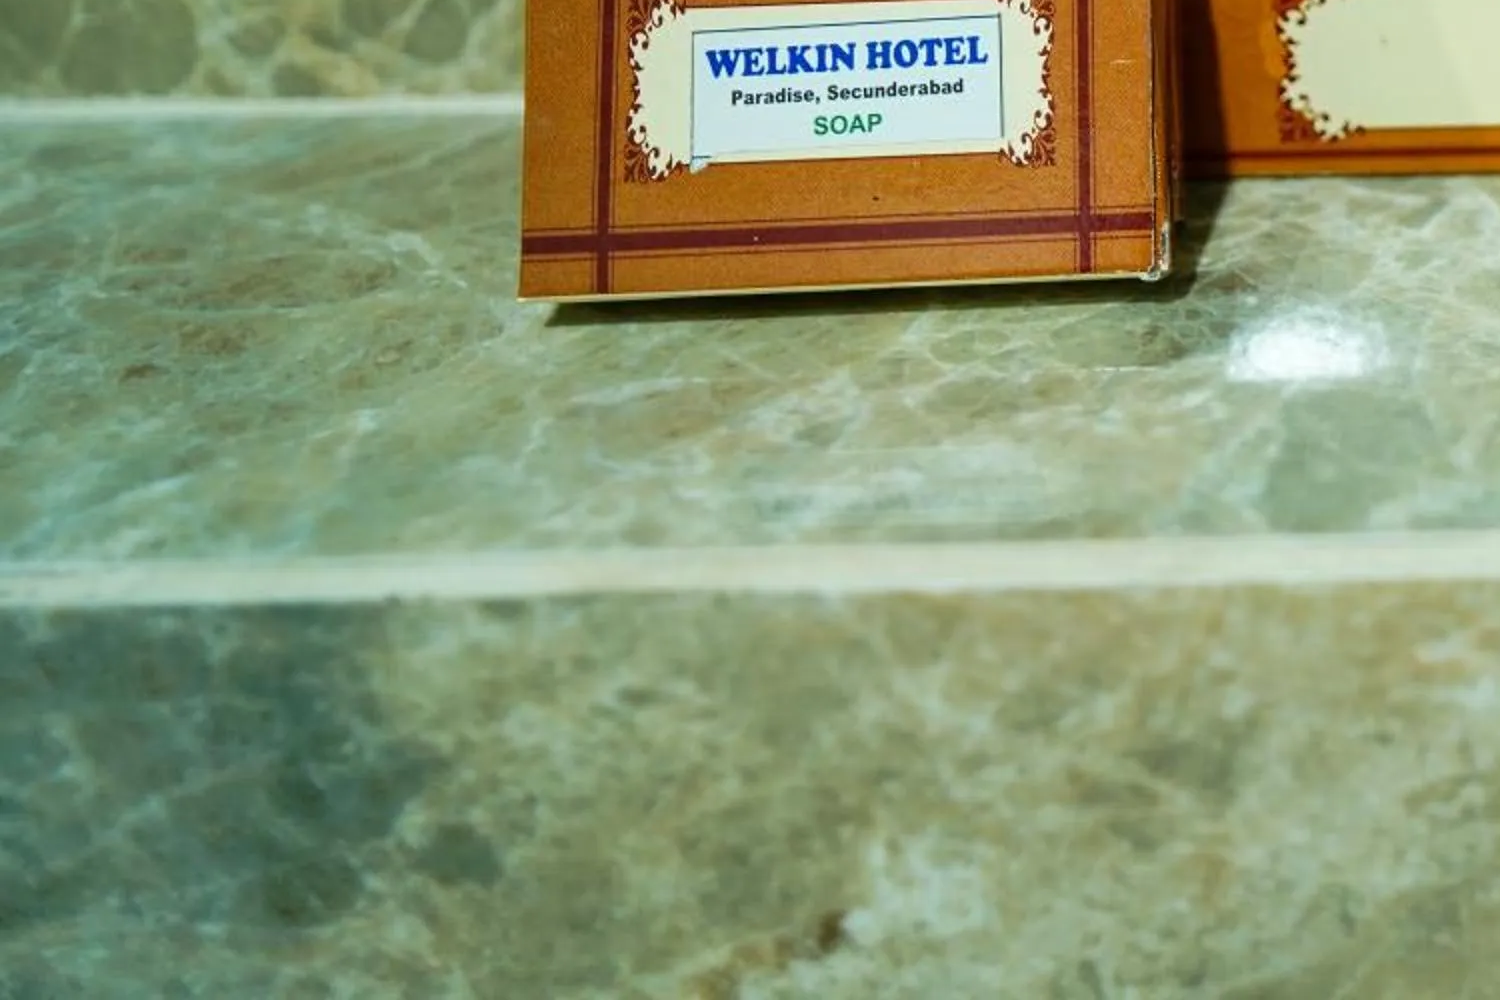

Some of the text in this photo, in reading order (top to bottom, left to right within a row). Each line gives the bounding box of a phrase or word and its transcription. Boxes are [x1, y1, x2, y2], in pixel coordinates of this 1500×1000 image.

[706, 35, 989, 79] WELKIN HOTEL
[731, 78, 964, 106] Paradise, Secunderabad
[814, 113, 882, 135] SOAP
